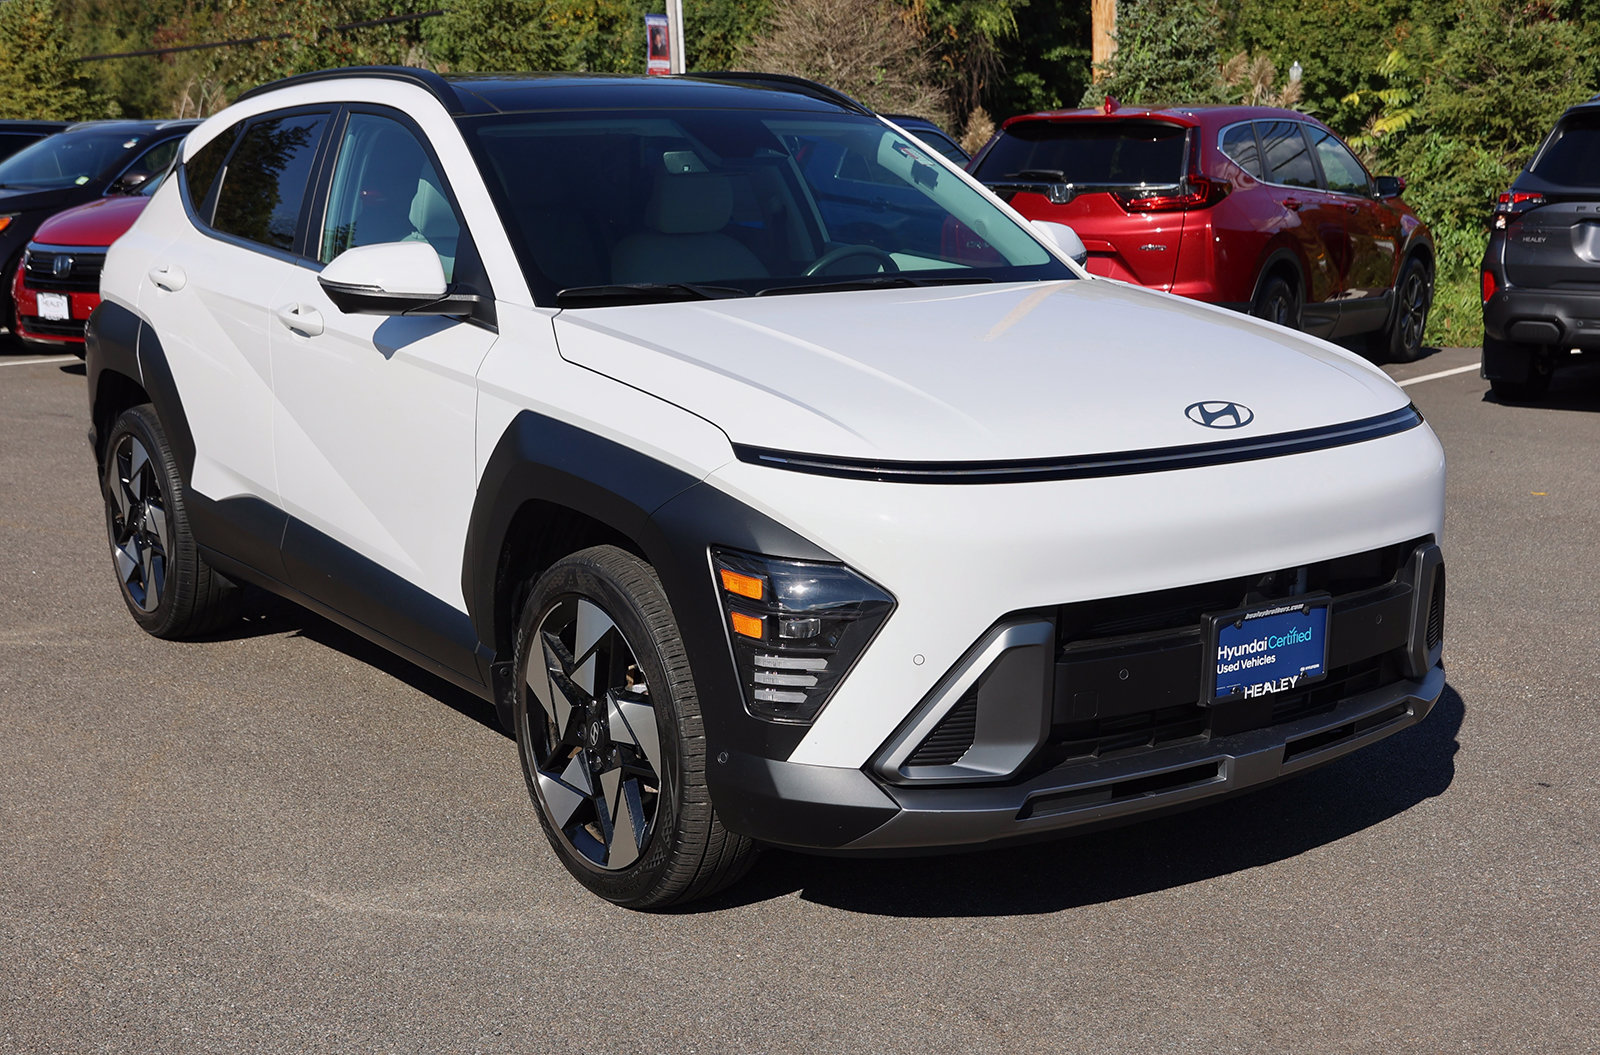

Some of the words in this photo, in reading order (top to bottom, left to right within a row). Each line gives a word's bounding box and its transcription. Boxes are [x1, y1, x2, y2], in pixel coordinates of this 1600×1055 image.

[1244, 603, 1305, 620] healeybrothers.com
[1217, 637, 1268, 661] Hyundai
[1268, 627, 1312, 649] Certified
[1216, 660, 1240, 674] Used
[1240, 655, 1276, 670] Vehicles
[1243, 675, 1299, 699] HEALEY
